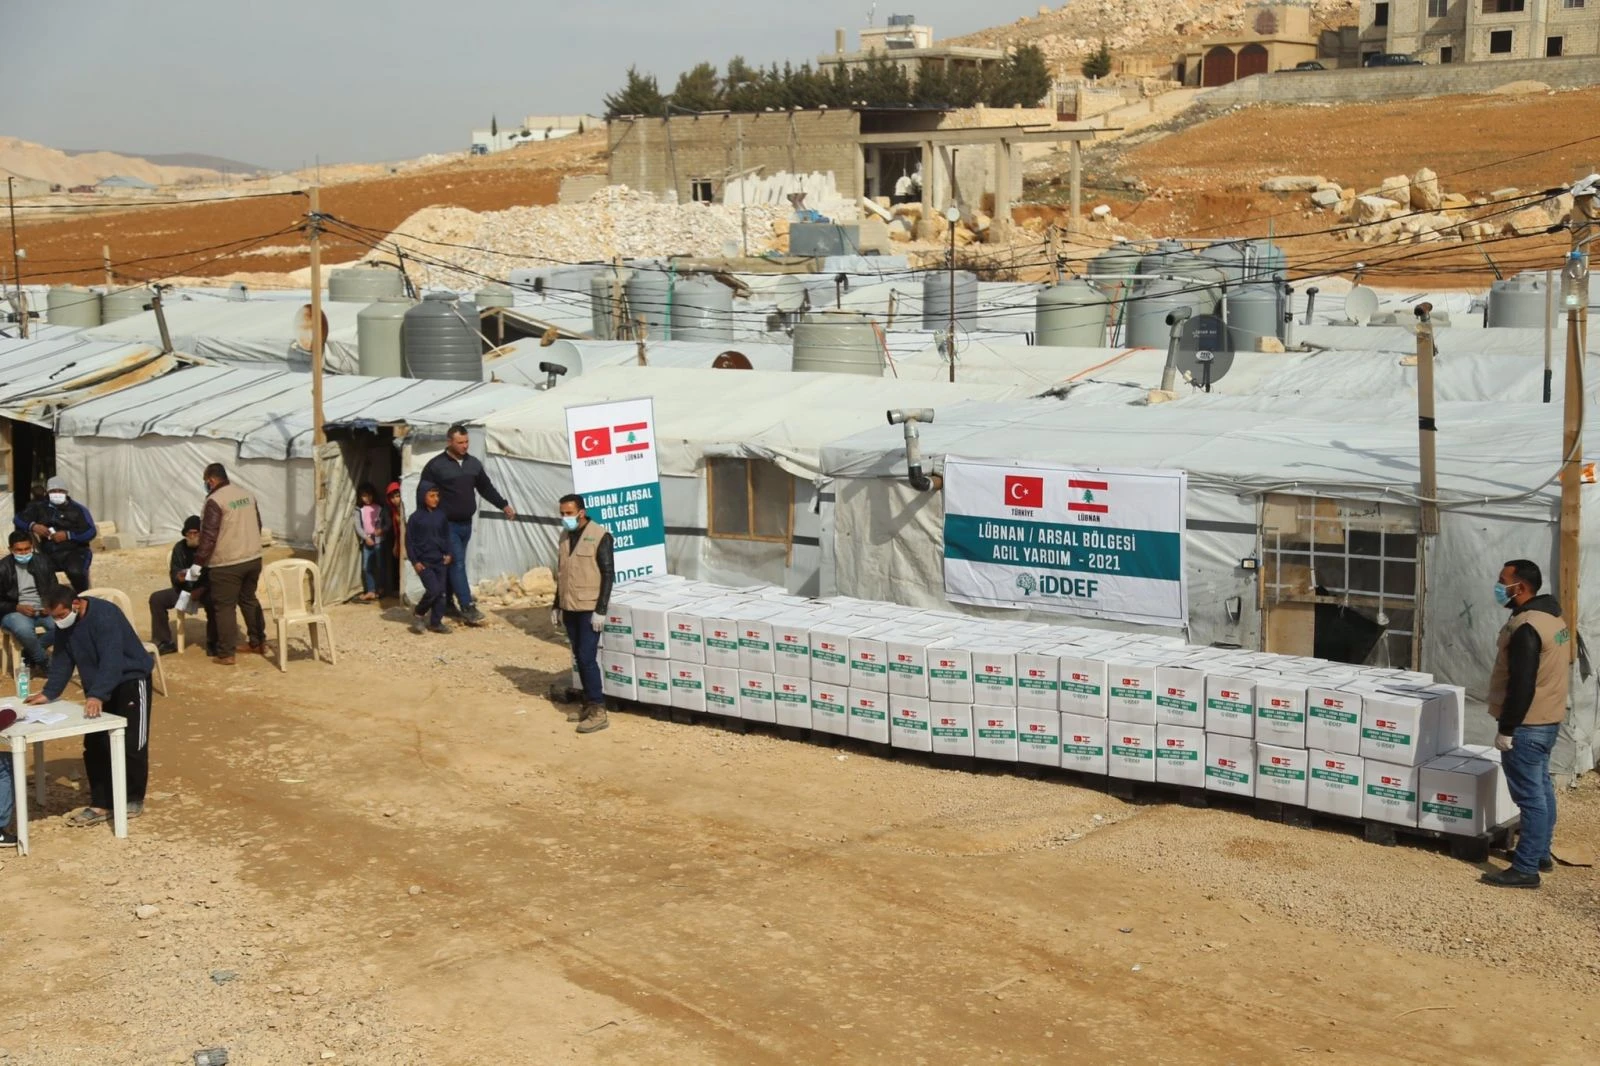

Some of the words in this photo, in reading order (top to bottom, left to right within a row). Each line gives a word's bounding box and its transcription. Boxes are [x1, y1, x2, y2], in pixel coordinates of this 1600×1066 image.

[583, 493, 618, 509] LÜBNAN
[620, 491, 624, 503] /
[626, 488, 653, 502] ARSAL
[601, 502, 639, 520] BÖLGESİ
[1011, 508, 1033, 517] TÜRKİYE
[1077, 513, 1100, 522] LÜBNAN
[615, 516, 650, 533] YARDIM
[613, 534, 635, 549] 2021
[979, 521, 1025, 542] LÜBNAN
[1029, 527, 1034, 543] /
[1038, 528, 1079, 546] ARSAL
[1083, 530, 1136, 552] BÖLGESİ
[1023, 547, 1071, 566] YARDIM
[1088, 553, 1120, 570] 2021
